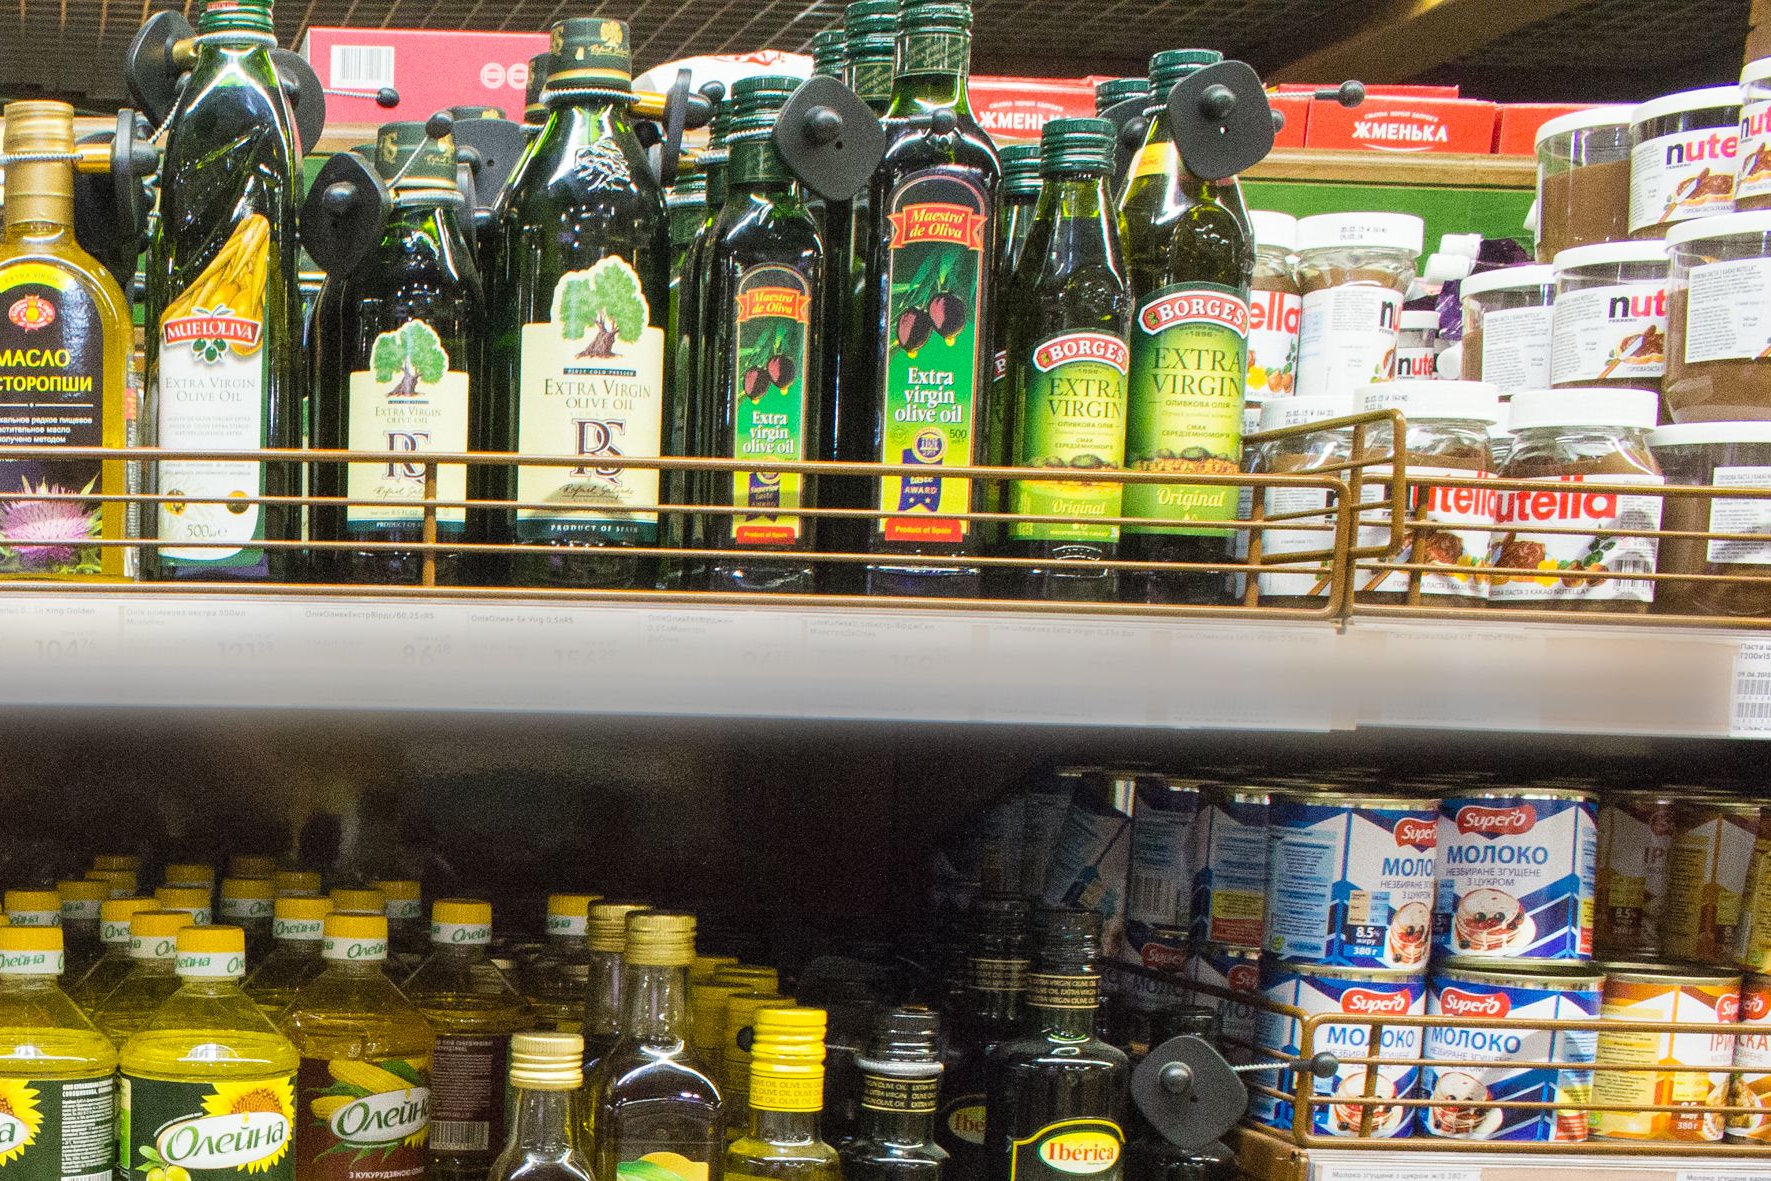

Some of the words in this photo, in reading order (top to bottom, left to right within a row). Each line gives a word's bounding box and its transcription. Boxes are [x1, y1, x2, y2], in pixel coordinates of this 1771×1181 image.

[979, 111, 1060, 130] ЖМЕНЬ
[1352, 120, 1448, 143] ЖМЕНЬКА
[909, 208, 966, 226] Maestro
[909, 223, 927, 238] de
[928, 223, 963, 240] Oliva
[1156, 297, 1245, 327] BORGES
[1049, 339, 1126, 366] BORGES
[1153, 348, 1241, 371] EXTRA
[544, 378, 597, 397] EXTRA
[603, 379, 651, 398] VIRGIN
[1153, 374, 1242, 398] VIRGIN
[565, 397, 608, 410] OLIVE
[613, 398, 635, 410] OIL
[751, 411, 788, 425] Extra
[748, 425, 789, 441] virgin
[742, 440, 773, 454] olive
[776, 439, 794, 454] oil
[1157, 487, 1224, 508] Original
[1447, 844, 1549, 865] МОЛОКО
[1445, 868, 1496, 878] НЕЗБИРАНЕ
[1498, 867, 1541, 878] ЗГУЩЕНЕ
[1353, 947, 1370, 956] 380
[1431, 1026, 1521, 1054] МОЛОКО
[165, 1120, 285, 1162] Олейна
[1048, 1142, 1114, 1162] Ibérica
